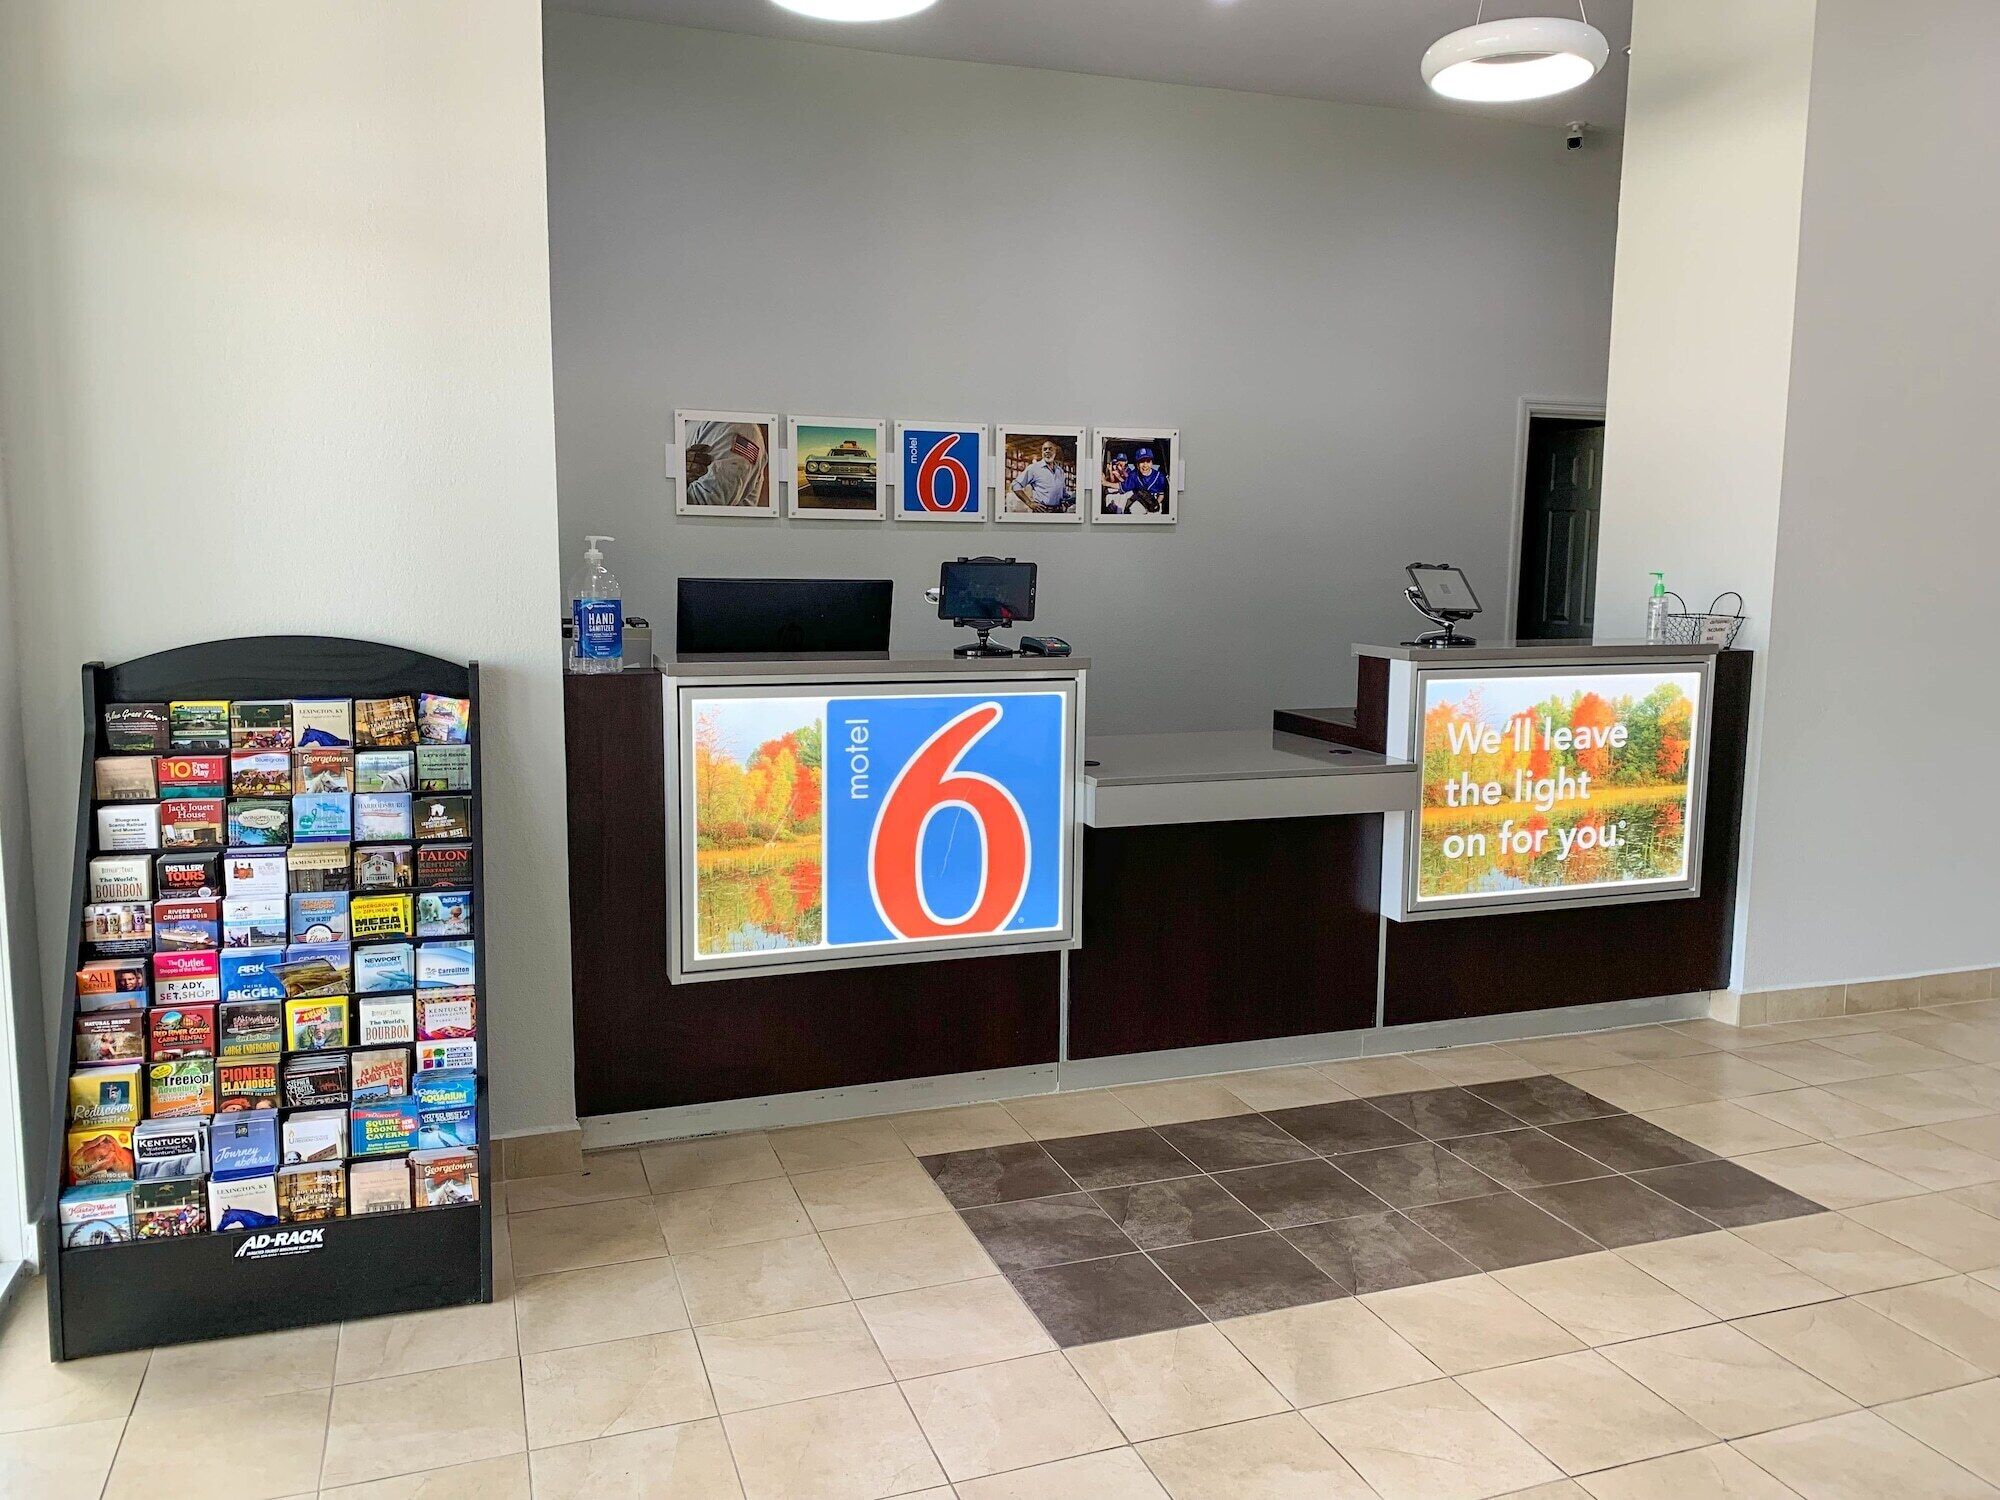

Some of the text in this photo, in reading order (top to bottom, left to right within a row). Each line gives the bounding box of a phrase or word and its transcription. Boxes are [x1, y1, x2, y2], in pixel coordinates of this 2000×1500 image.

[909, 437, 917, 464] motel
[916, 433, 970, 513] 6
[588, 613, 614, 625] HAND
[588, 624, 614, 632] SANITIZER
[104, 710, 121, 722] Blue
[122, 709, 141, 720] Grass
[1446, 716, 1629, 756] We'll leave
[302, 754, 349, 764] Georgetown
[845, 718, 870, 800] motel
[191, 762, 209, 770] Free
[192, 769, 209, 778] Play
[1445, 766, 1592, 812] the light
[168, 803, 214, 813] Jack Jouett
[177, 810, 206, 819] House
[868, 700, 1032, 940] 6
[1442, 832, 1486, 859] on
[1498, 820, 1549, 855] for
[419, 850, 468, 861] TALON
[165, 863, 204, 873] DISTILLERY
[166, 871, 206, 881] TOURS
[95, 882, 142, 898] BOURBON
[353, 902, 399, 910] UNDERGROUND
[355, 916, 401, 926] MEGA
[355, 924, 402, 933] CAVERN
[177, 958, 205, 968] Outlet
[237, 961, 266, 974] ARK
[89, 972, 111, 983] ALI
[182, 990, 215, 999] SHOP!
[227, 987, 279, 1000] BIGGER
[153, 1030, 167, 1038] RED
[169, 1028, 188, 1036] RIVER
[366, 1024, 409, 1041] BOURBON
[158, 1035, 178, 1043] CABIN
[220, 1066, 275, 1081] PIONEER
[361, 1060, 404, 1076] All Aboard for
[164, 1074, 209, 1086] Treetop
[221, 1078, 276, 1092] PLAYHOUSE
[355, 1071, 383, 1088] FAMILY
[158, 1085, 198, 1094] Adventure
[420, 1091, 467, 1104] AQUARIUM
[74, 1102, 135, 1119] Rediscover
[366, 1118, 400, 1128] SQUIRE
[366, 1125, 400, 1134] BOONE
[139, 1136, 194, 1148] KENTUCKY
[366, 1131, 410, 1141] CAVERNS
[141, 1149, 176, 1157] Adventure
[146, 1144, 181, 1152] Waterways
[214, 1146, 261, 1164] Journey
[234, 1152, 271, 1168] aboard
[424, 1161, 474, 1176] Georgetown
[234, 1228, 325, 1257] AD-RACK
